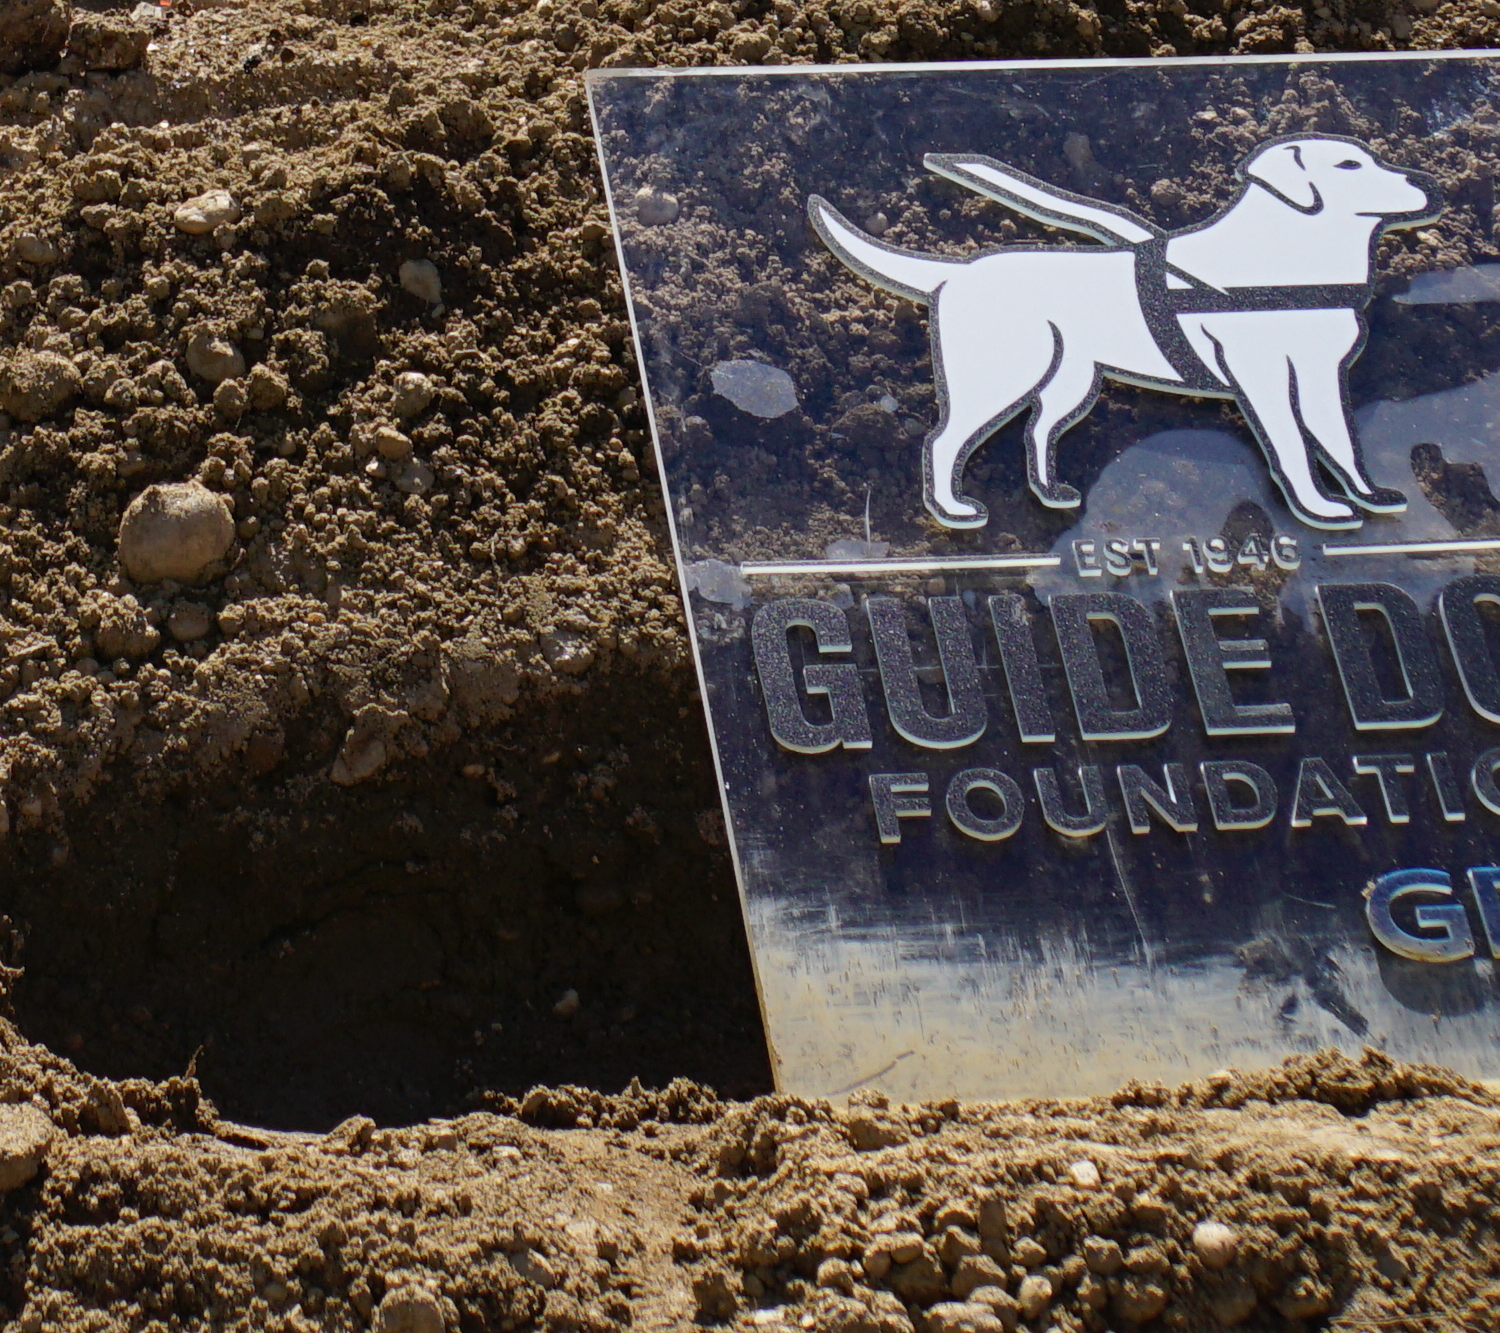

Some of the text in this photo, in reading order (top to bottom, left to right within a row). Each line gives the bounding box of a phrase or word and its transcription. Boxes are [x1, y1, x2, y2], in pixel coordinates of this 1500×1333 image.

[1072, 532, 1301, 577] EST 1946
[748, 586, 1297, 754] GUIDE
